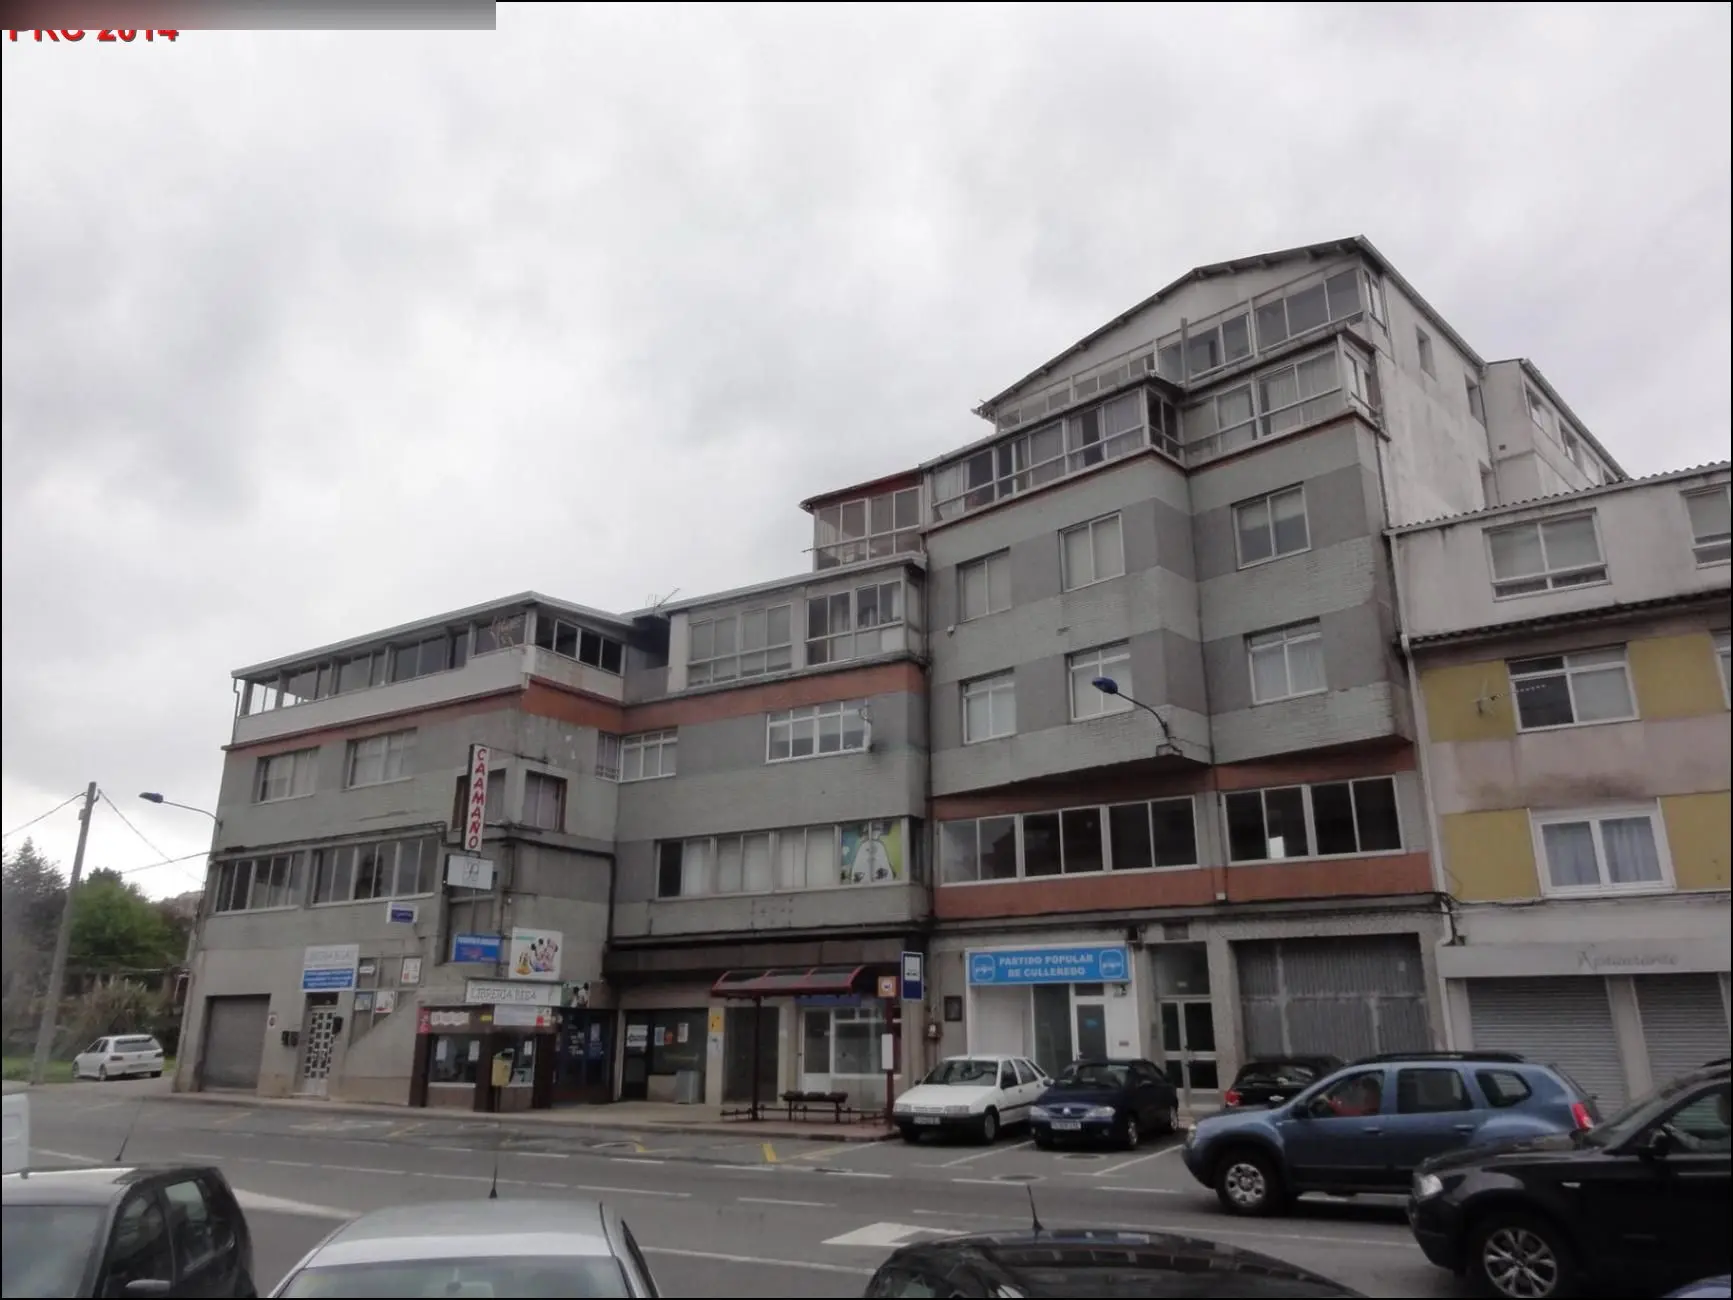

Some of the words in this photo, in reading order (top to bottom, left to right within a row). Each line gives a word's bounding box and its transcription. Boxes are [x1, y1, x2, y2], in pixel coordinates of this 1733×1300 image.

[998, 956, 1043, 967] PARTIDO
[1045, 953, 1095, 965] POPULAR
[1007, 967, 1021, 978] DE
[1023, 966, 1087, 978] CULLEREDO
